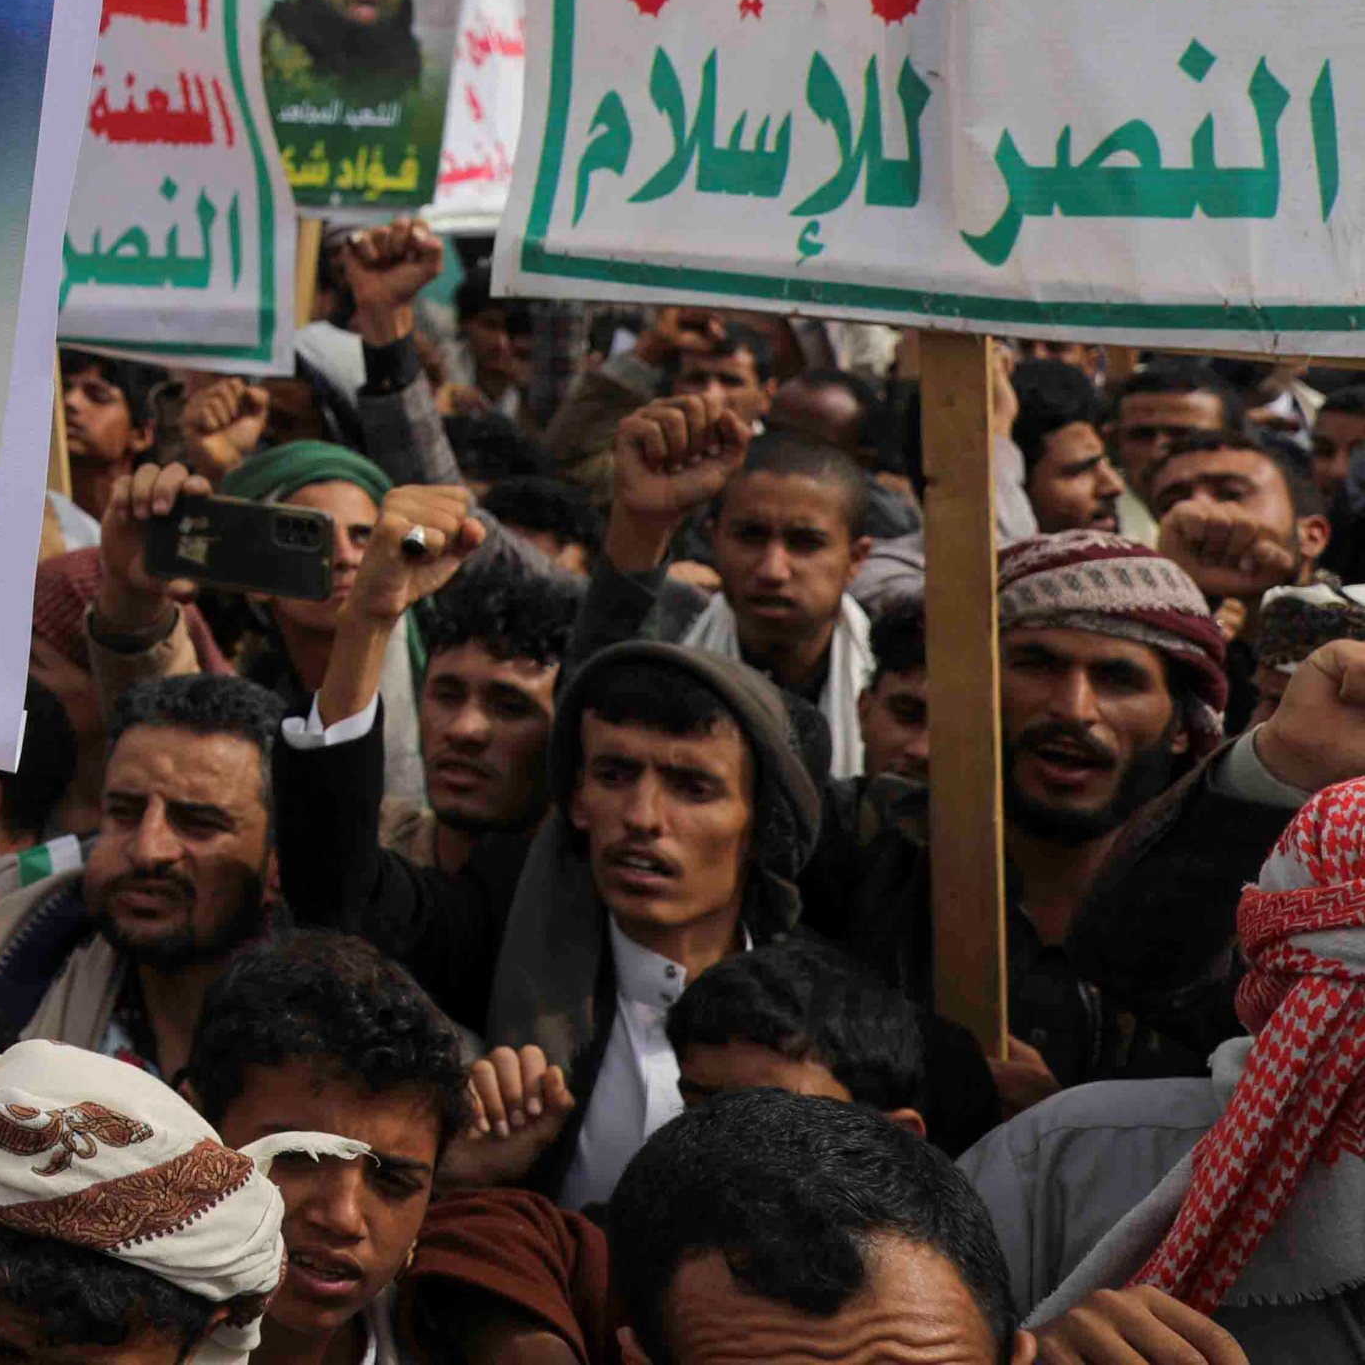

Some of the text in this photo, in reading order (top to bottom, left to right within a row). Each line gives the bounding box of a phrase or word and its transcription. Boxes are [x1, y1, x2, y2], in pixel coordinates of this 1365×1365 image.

[282, 137, 330, 187] شك
[335, 142, 419, 202] فؤاد
[572, 36, 1339, 268] النصر للإسلام
